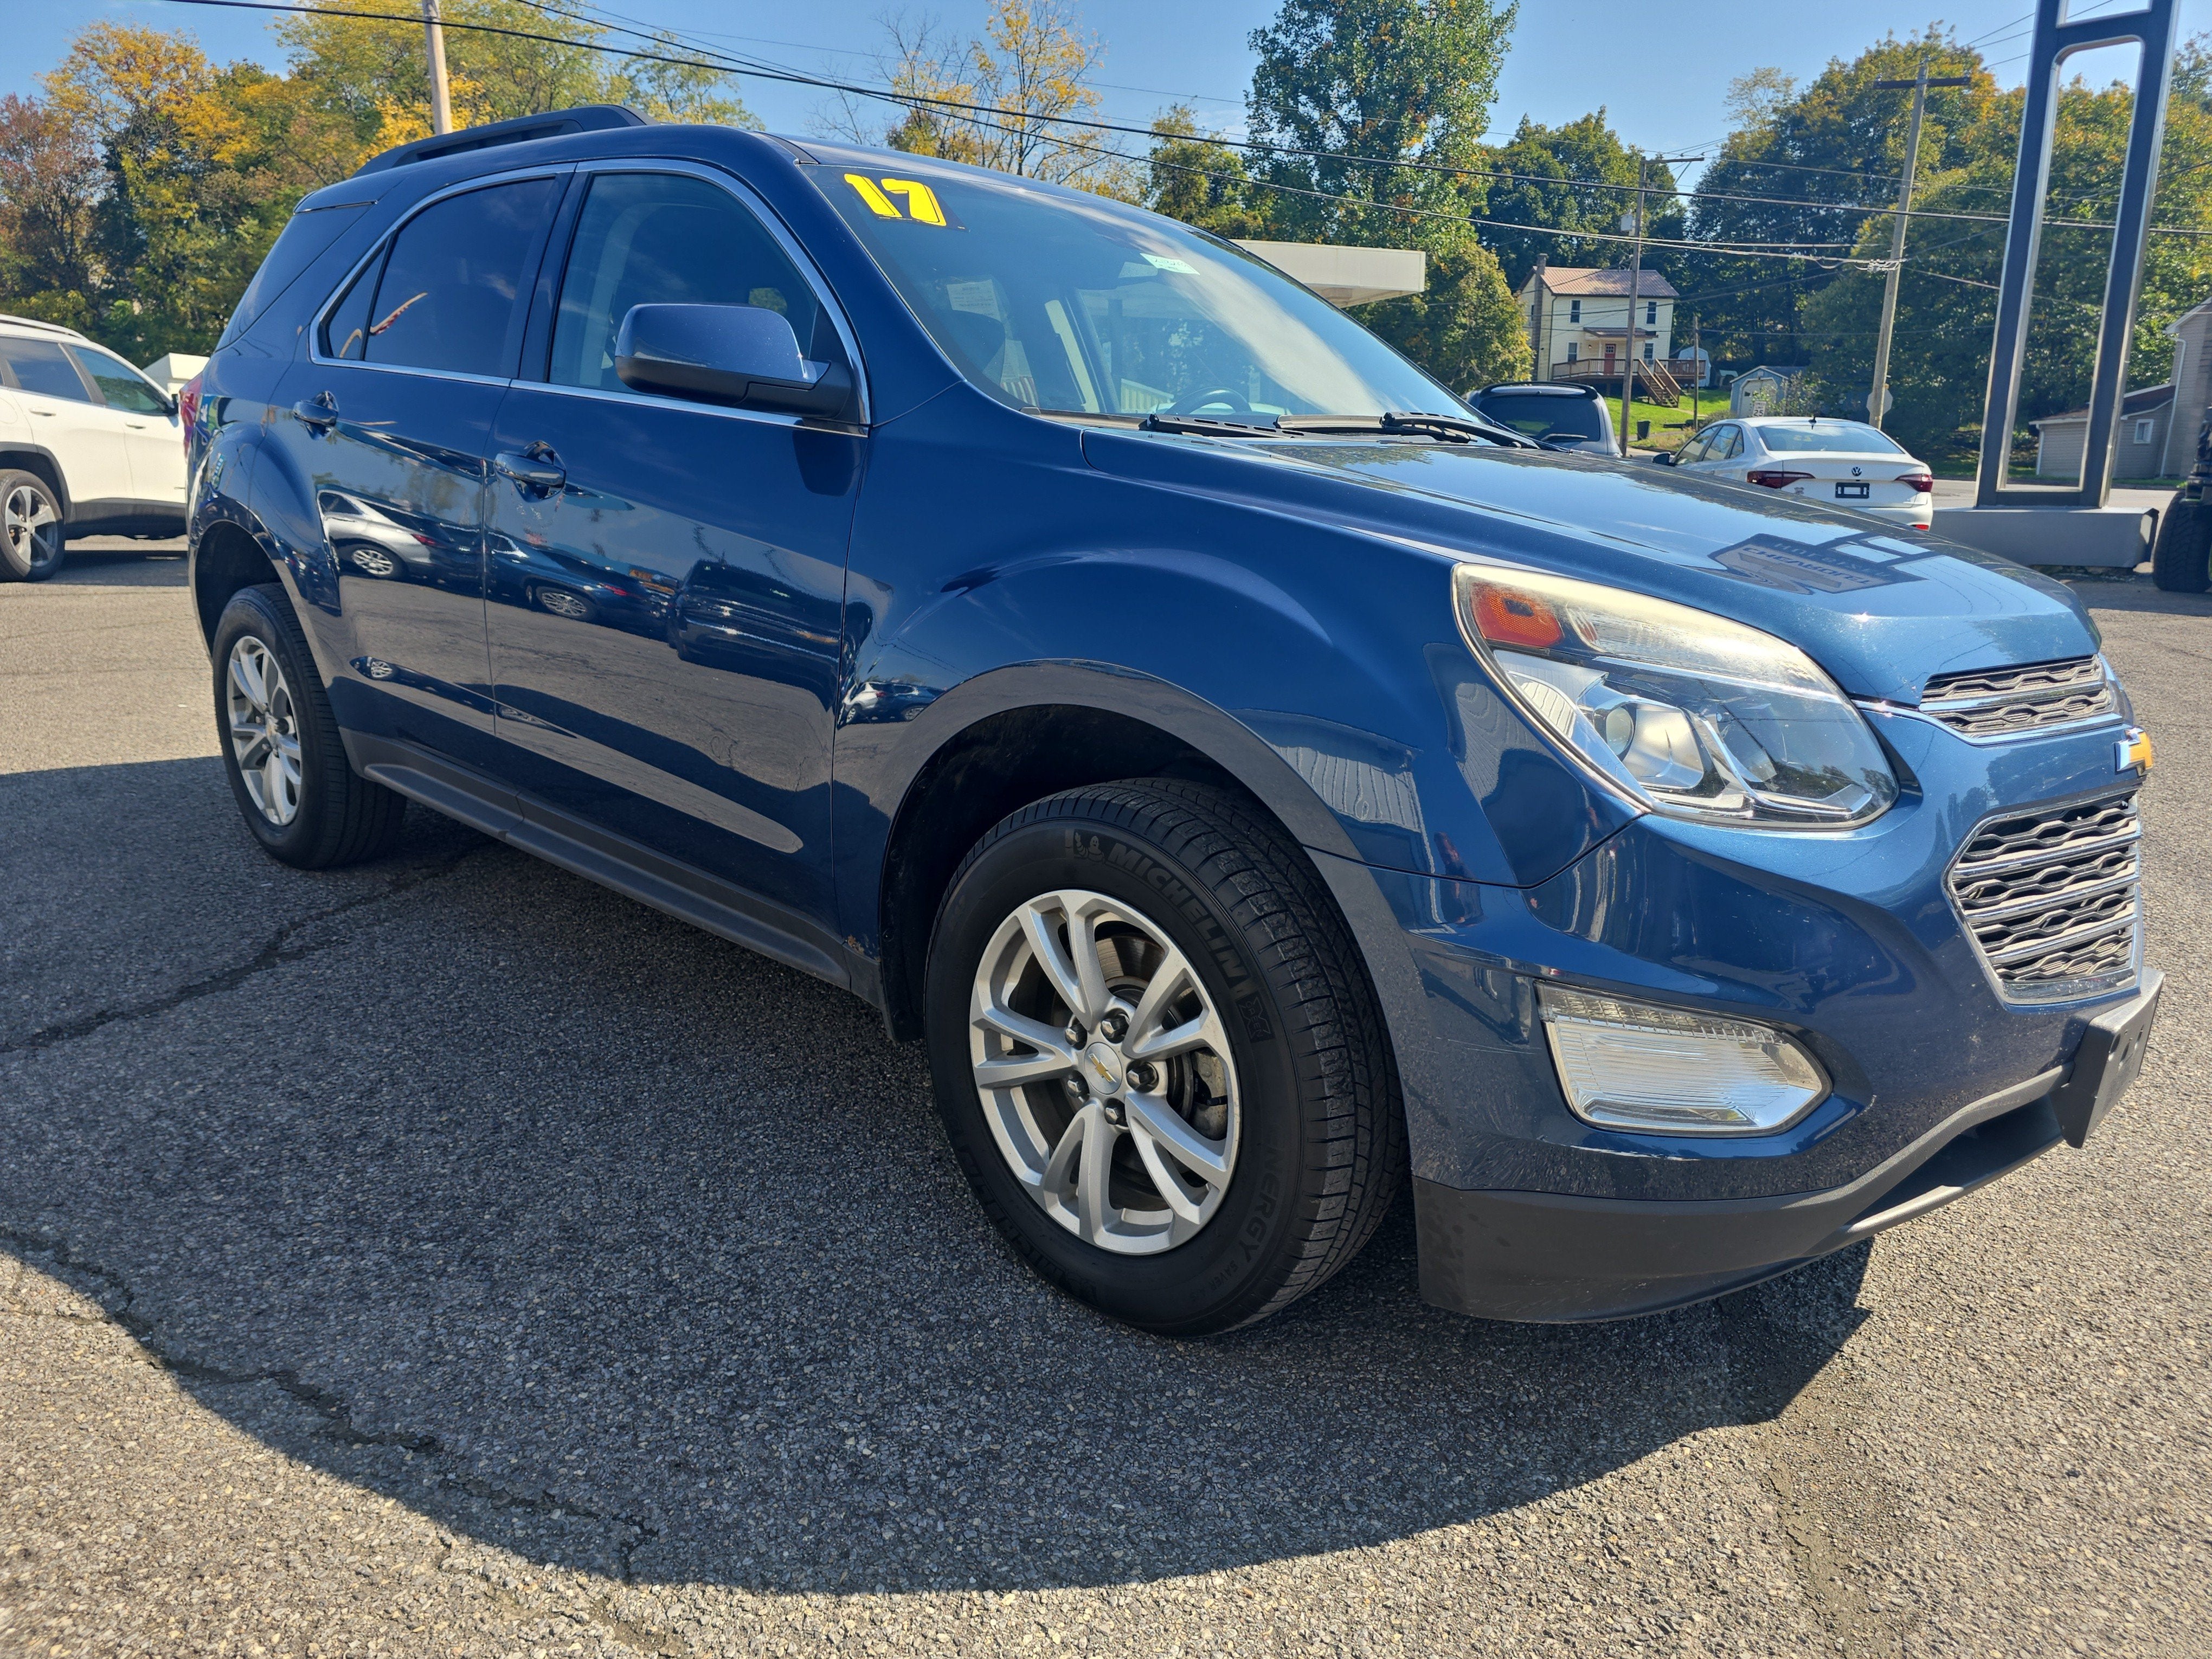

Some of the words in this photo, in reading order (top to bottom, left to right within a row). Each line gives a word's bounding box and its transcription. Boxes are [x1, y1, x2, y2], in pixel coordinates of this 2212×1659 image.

[844, 173, 947, 226] 17
[1107, 842, 1247, 982] MICHELIN
[1238, 1133, 1281, 1263] NERGY
[1208, 1259, 1239, 1291] SAVER
